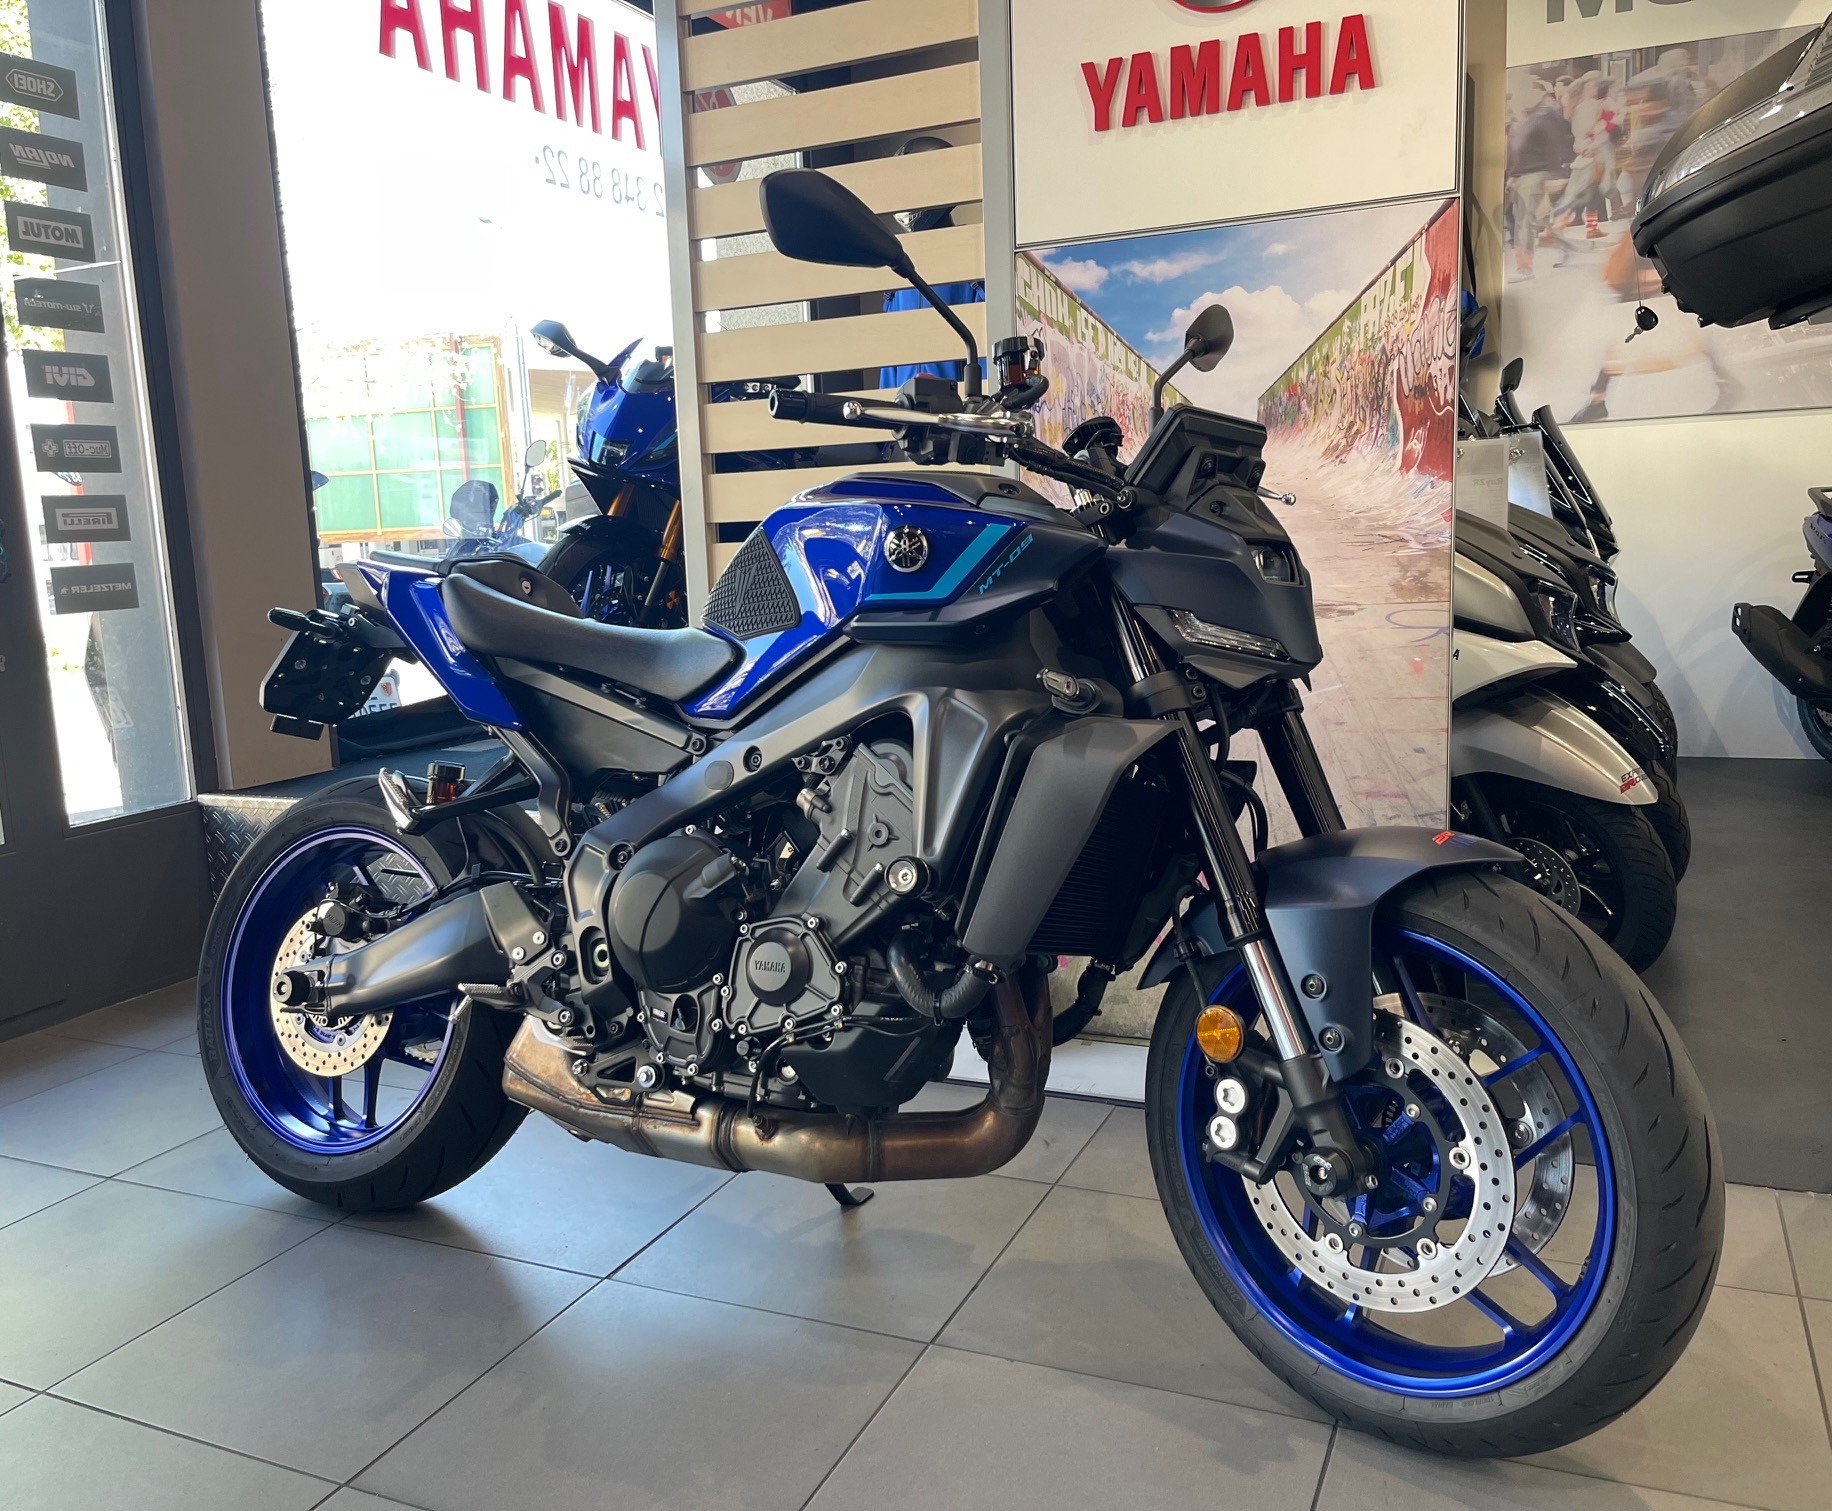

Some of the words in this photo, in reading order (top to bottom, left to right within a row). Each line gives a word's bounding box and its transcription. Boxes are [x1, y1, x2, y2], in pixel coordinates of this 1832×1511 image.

[1081, 14, 1376, 132] YAMAHA
[977, 533, 1035, 596] MT-09
[754, 959, 786, 974] YAMAHA
